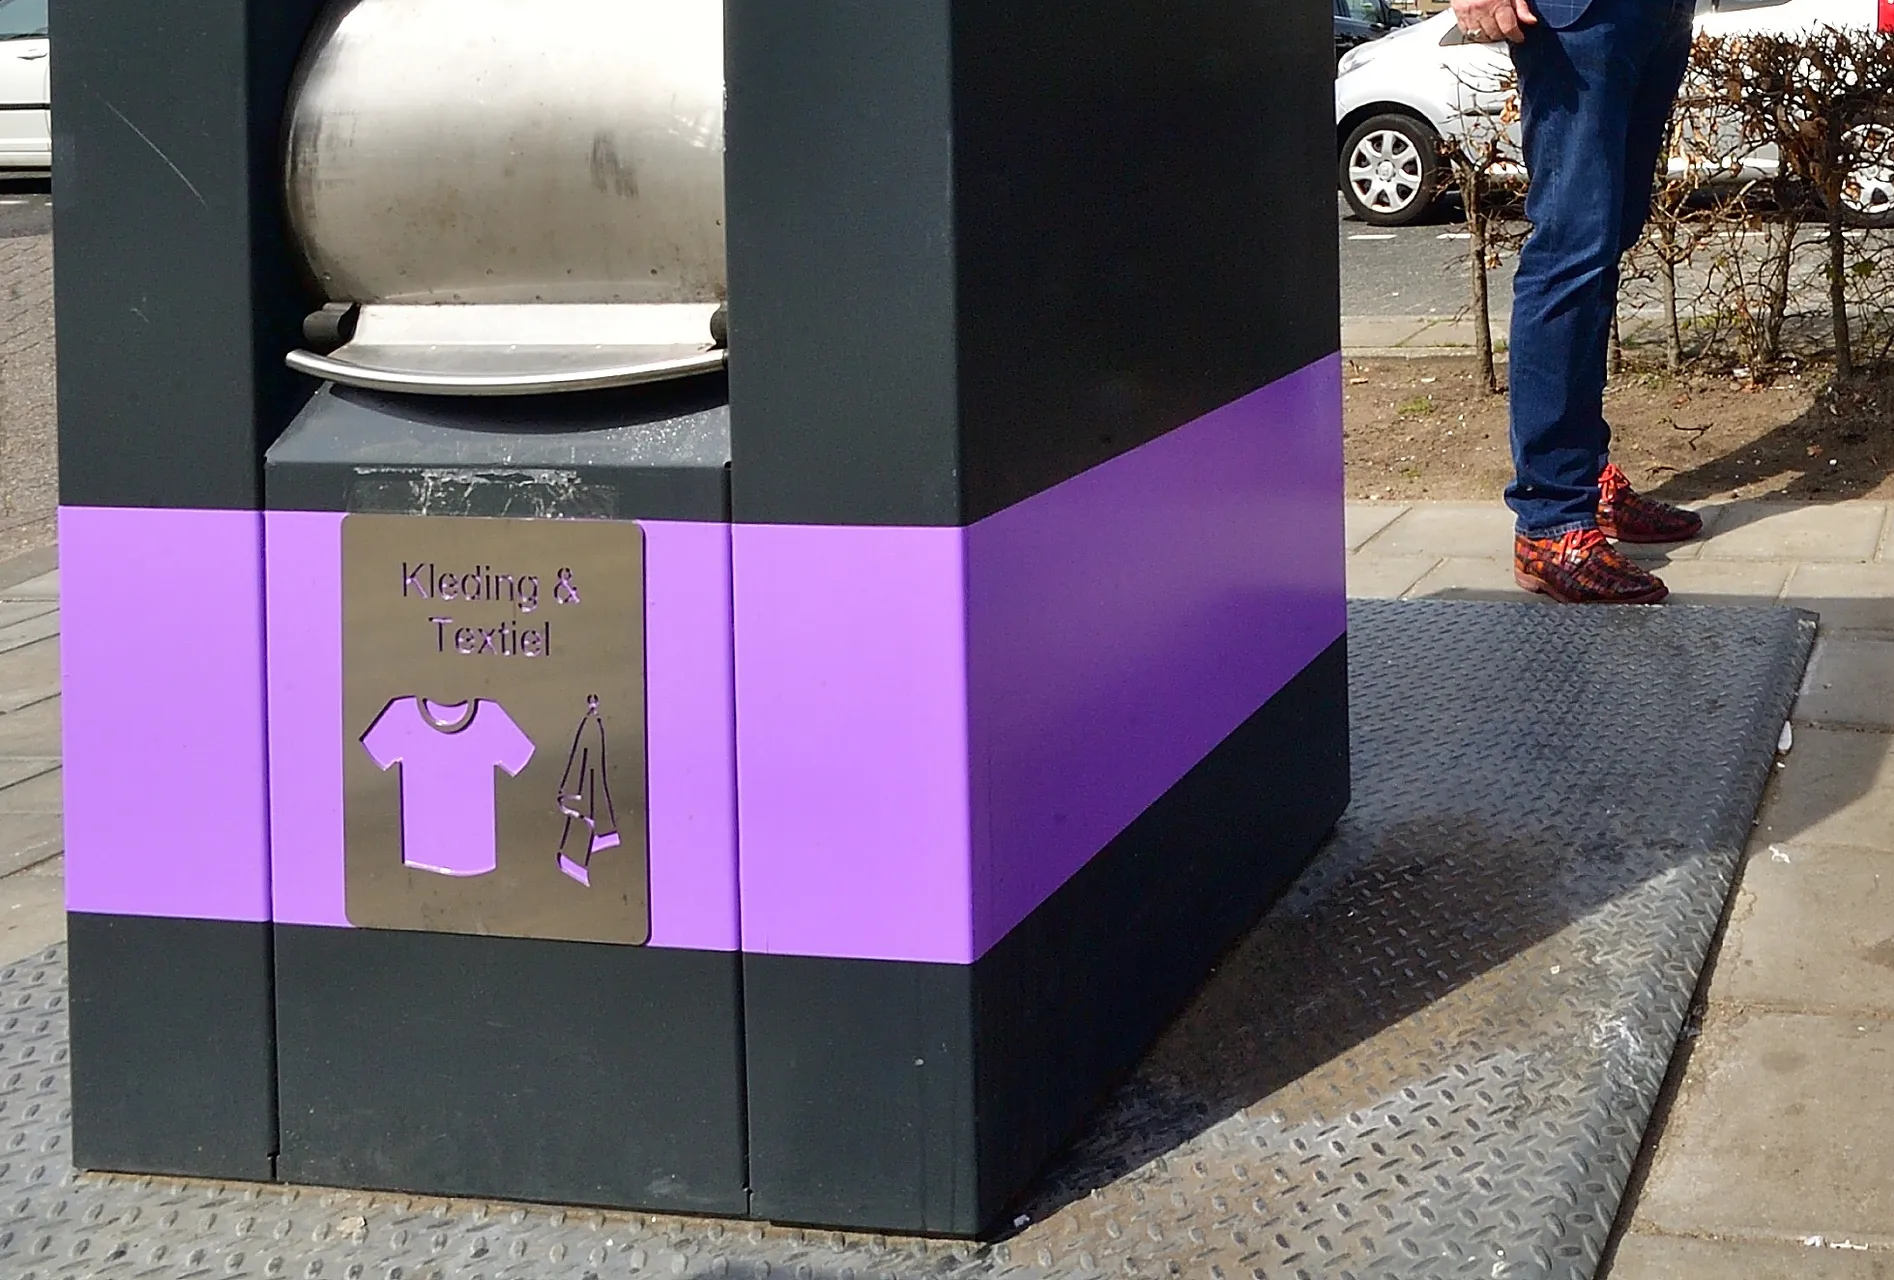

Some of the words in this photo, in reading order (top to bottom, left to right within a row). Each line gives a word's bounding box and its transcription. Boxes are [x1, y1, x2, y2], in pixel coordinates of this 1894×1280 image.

[402, 562, 539, 613] Kleding
[553, 567, 581, 605] &
[428, 616, 550, 657] Textiel
